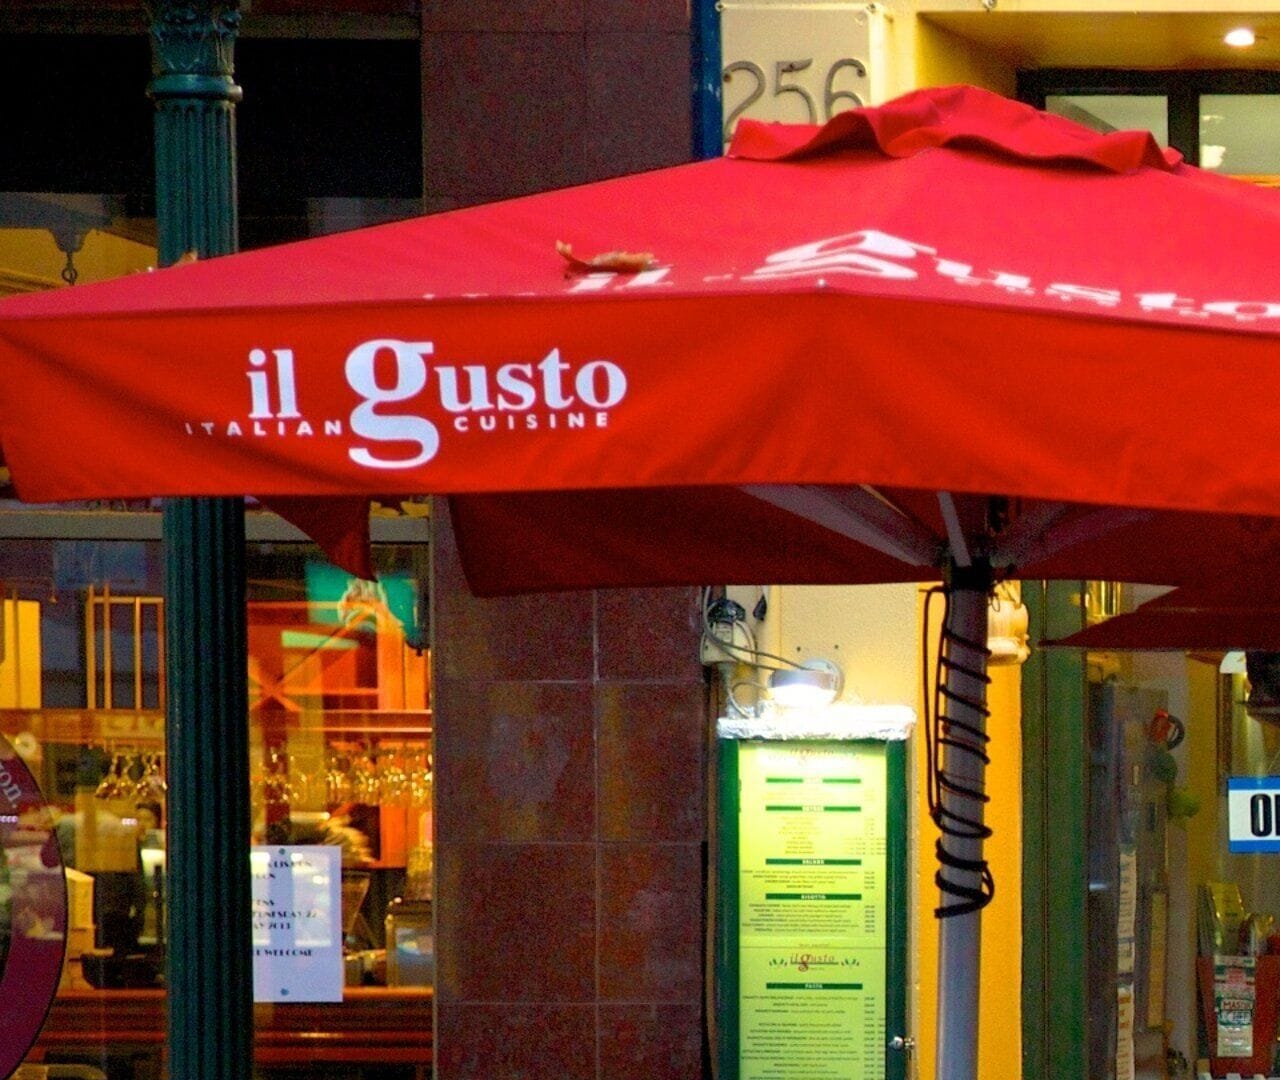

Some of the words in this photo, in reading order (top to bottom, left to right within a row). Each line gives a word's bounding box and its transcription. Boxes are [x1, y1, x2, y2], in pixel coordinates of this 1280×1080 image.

[724, 58, 866, 143] 256
[185, 420, 342, 437] ITALIAN
[454, 411, 609, 433] CUISINE
[246, 349, 300, 419] il
[345, 338, 627, 470] gusto
